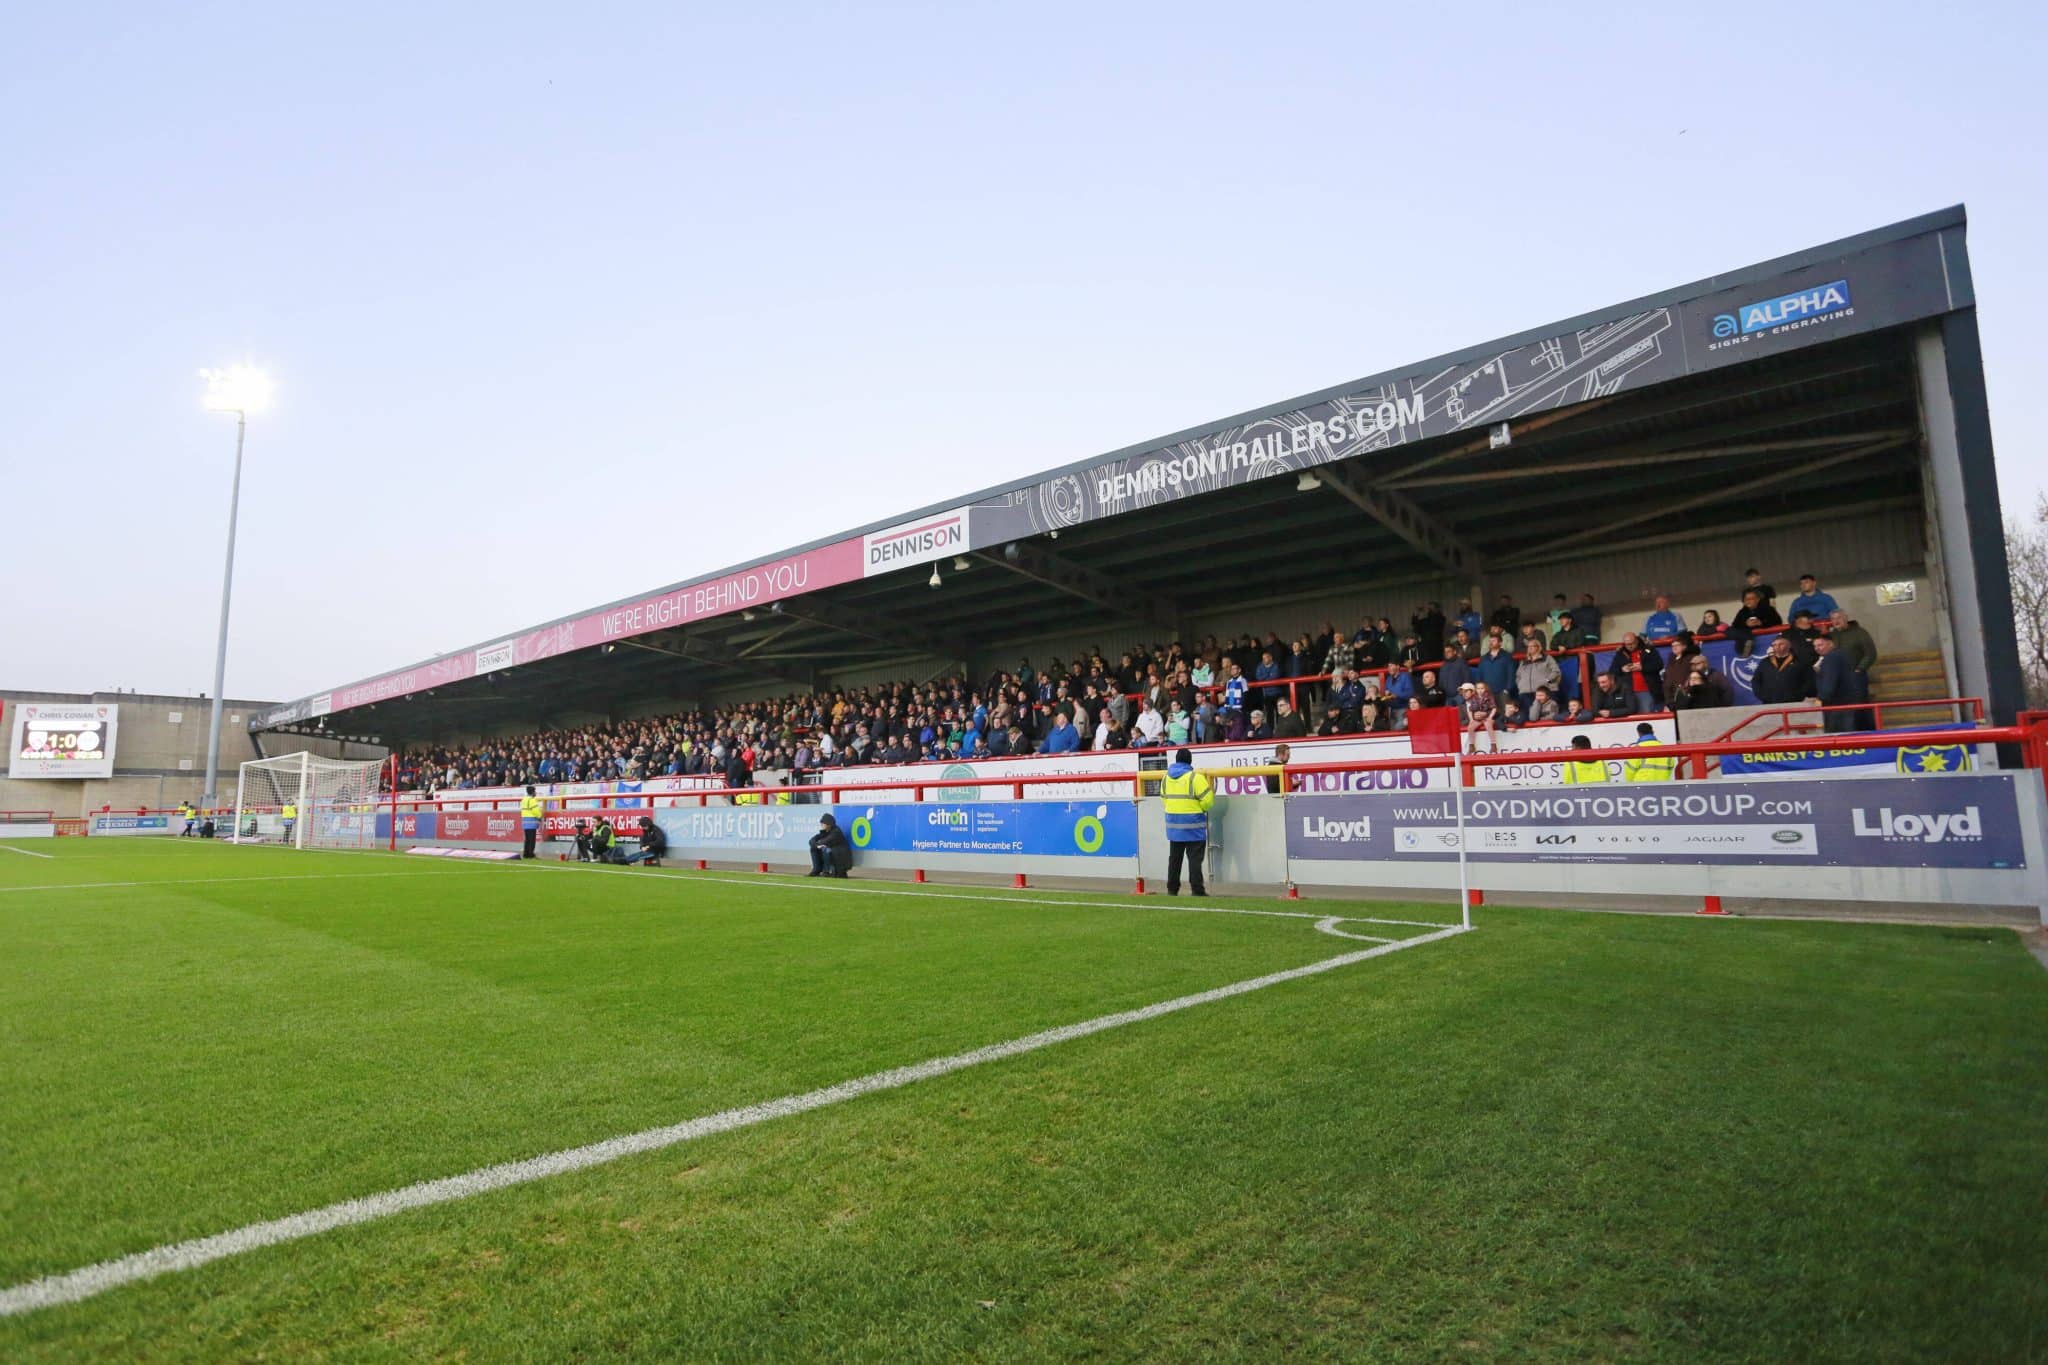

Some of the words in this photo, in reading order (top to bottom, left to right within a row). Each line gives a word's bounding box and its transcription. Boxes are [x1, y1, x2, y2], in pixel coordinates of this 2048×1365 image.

[1745, 287, 1846, 329] ALPHA
[1708, 335, 1750, 351] SIGNS
[1757, 331, 1765, 339] &
[1772, 307, 1855, 334] ENGRAVING
[1098, 394, 1425, 503] DENNISONTRAILERS.COM
[870, 524, 961, 564] DENNISON
[602, 607, 642, 637] WE'RE
[646, 593, 691, 627] RIGHT
[695, 574, 760, 614] BEHIND
[764, 559, 808, 595] YOU
[48, 733, 77, 749] 1:0
[1742, 751, 1825, 763] BANKSY'S
[1484, 764, 1544, 781] RADIO
[98, 821, 138, 829] CEMIST
[394, 816, 404, 835] ky
[404, 817, 415, 832] bet
[543, 816, 580, 831] HEYSHA
[617, 815, 626, 830] &
[692, 812, 723, 838] FISH
[726, 813, 735, 833] &
[737, 812, 785, 839] CHIPS
[1303, 815, 1371, 842] Lloyd
[1851, 806, 1982, 842] Lloyd
[912, 840, 938, 850] Hygiene
[939, 840, 963, 849] Partner
[963, 841, 971, 849] to
[971, 841, 1011, 850] Morecambe
[1012, 841, 1023, 850] FC
